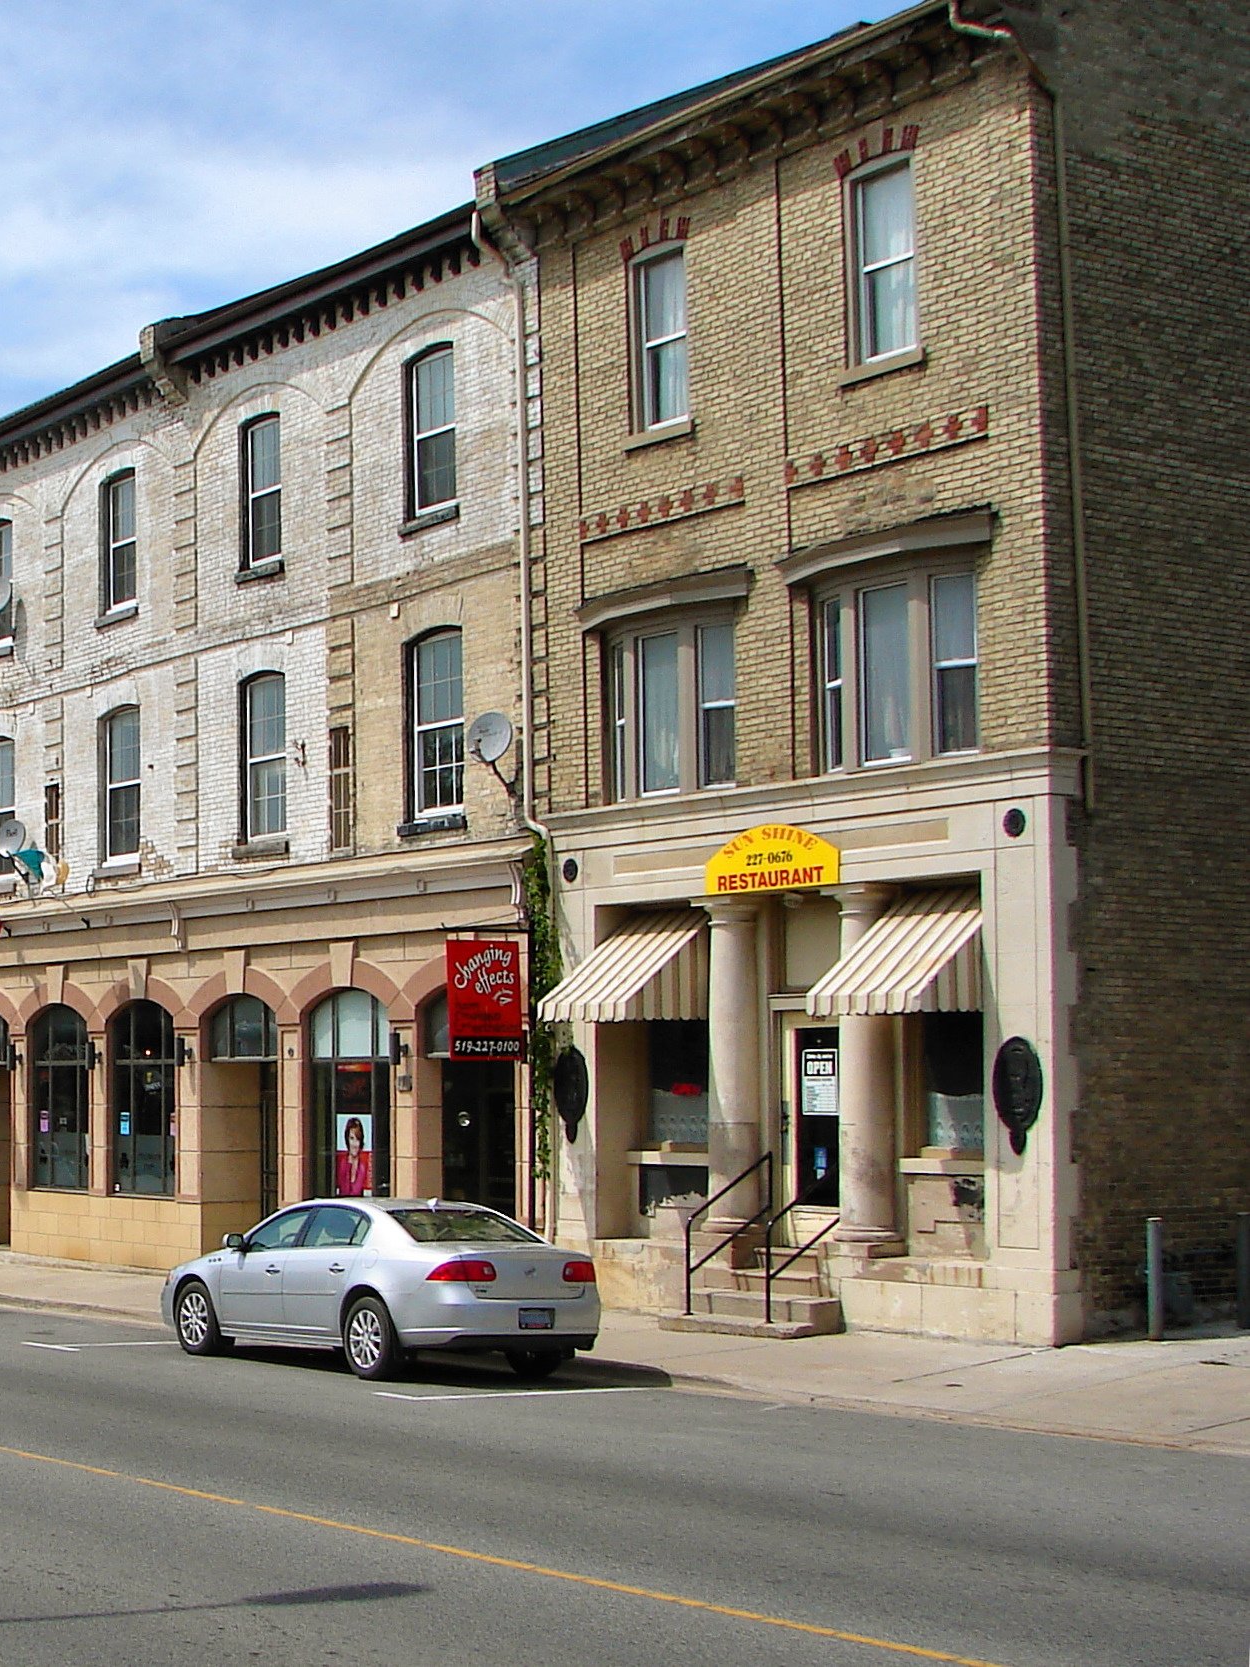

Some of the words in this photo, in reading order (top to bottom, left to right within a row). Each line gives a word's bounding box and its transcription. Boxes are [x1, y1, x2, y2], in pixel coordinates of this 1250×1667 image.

[723, 832, 754, 858] SUN
[761, 827, 818, 850] SHINE
[746, 851, 793, 866] 227-0676
[717, 866, 824, 891] RESTAURANT
[454, 944, 512, 989] Changing
[475, 966, 515, 995] effects
[454, 1040, 520, 1053] 519-227-0100
[806, 1061, 833, 1075] OPEN
